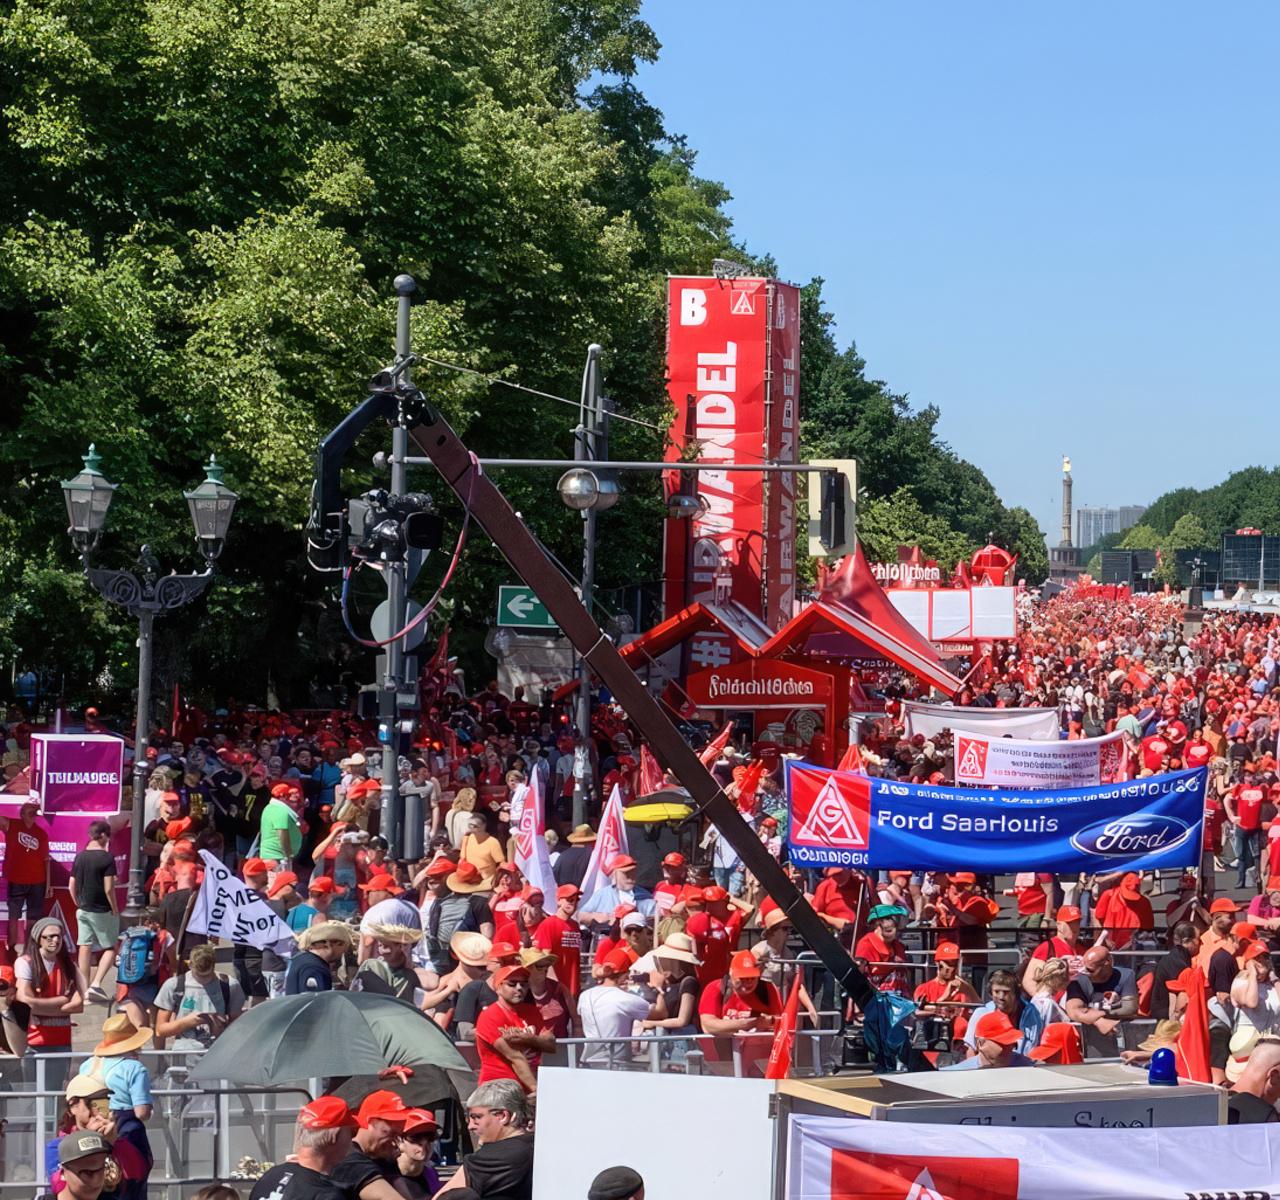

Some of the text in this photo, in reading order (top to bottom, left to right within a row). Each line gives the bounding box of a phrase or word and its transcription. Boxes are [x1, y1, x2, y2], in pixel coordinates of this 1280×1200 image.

[680, 288, 707, 326] B
[877, 810, 1058, 833] Ford Saarlouis
[1095, 821, 1172, 851] Ford
